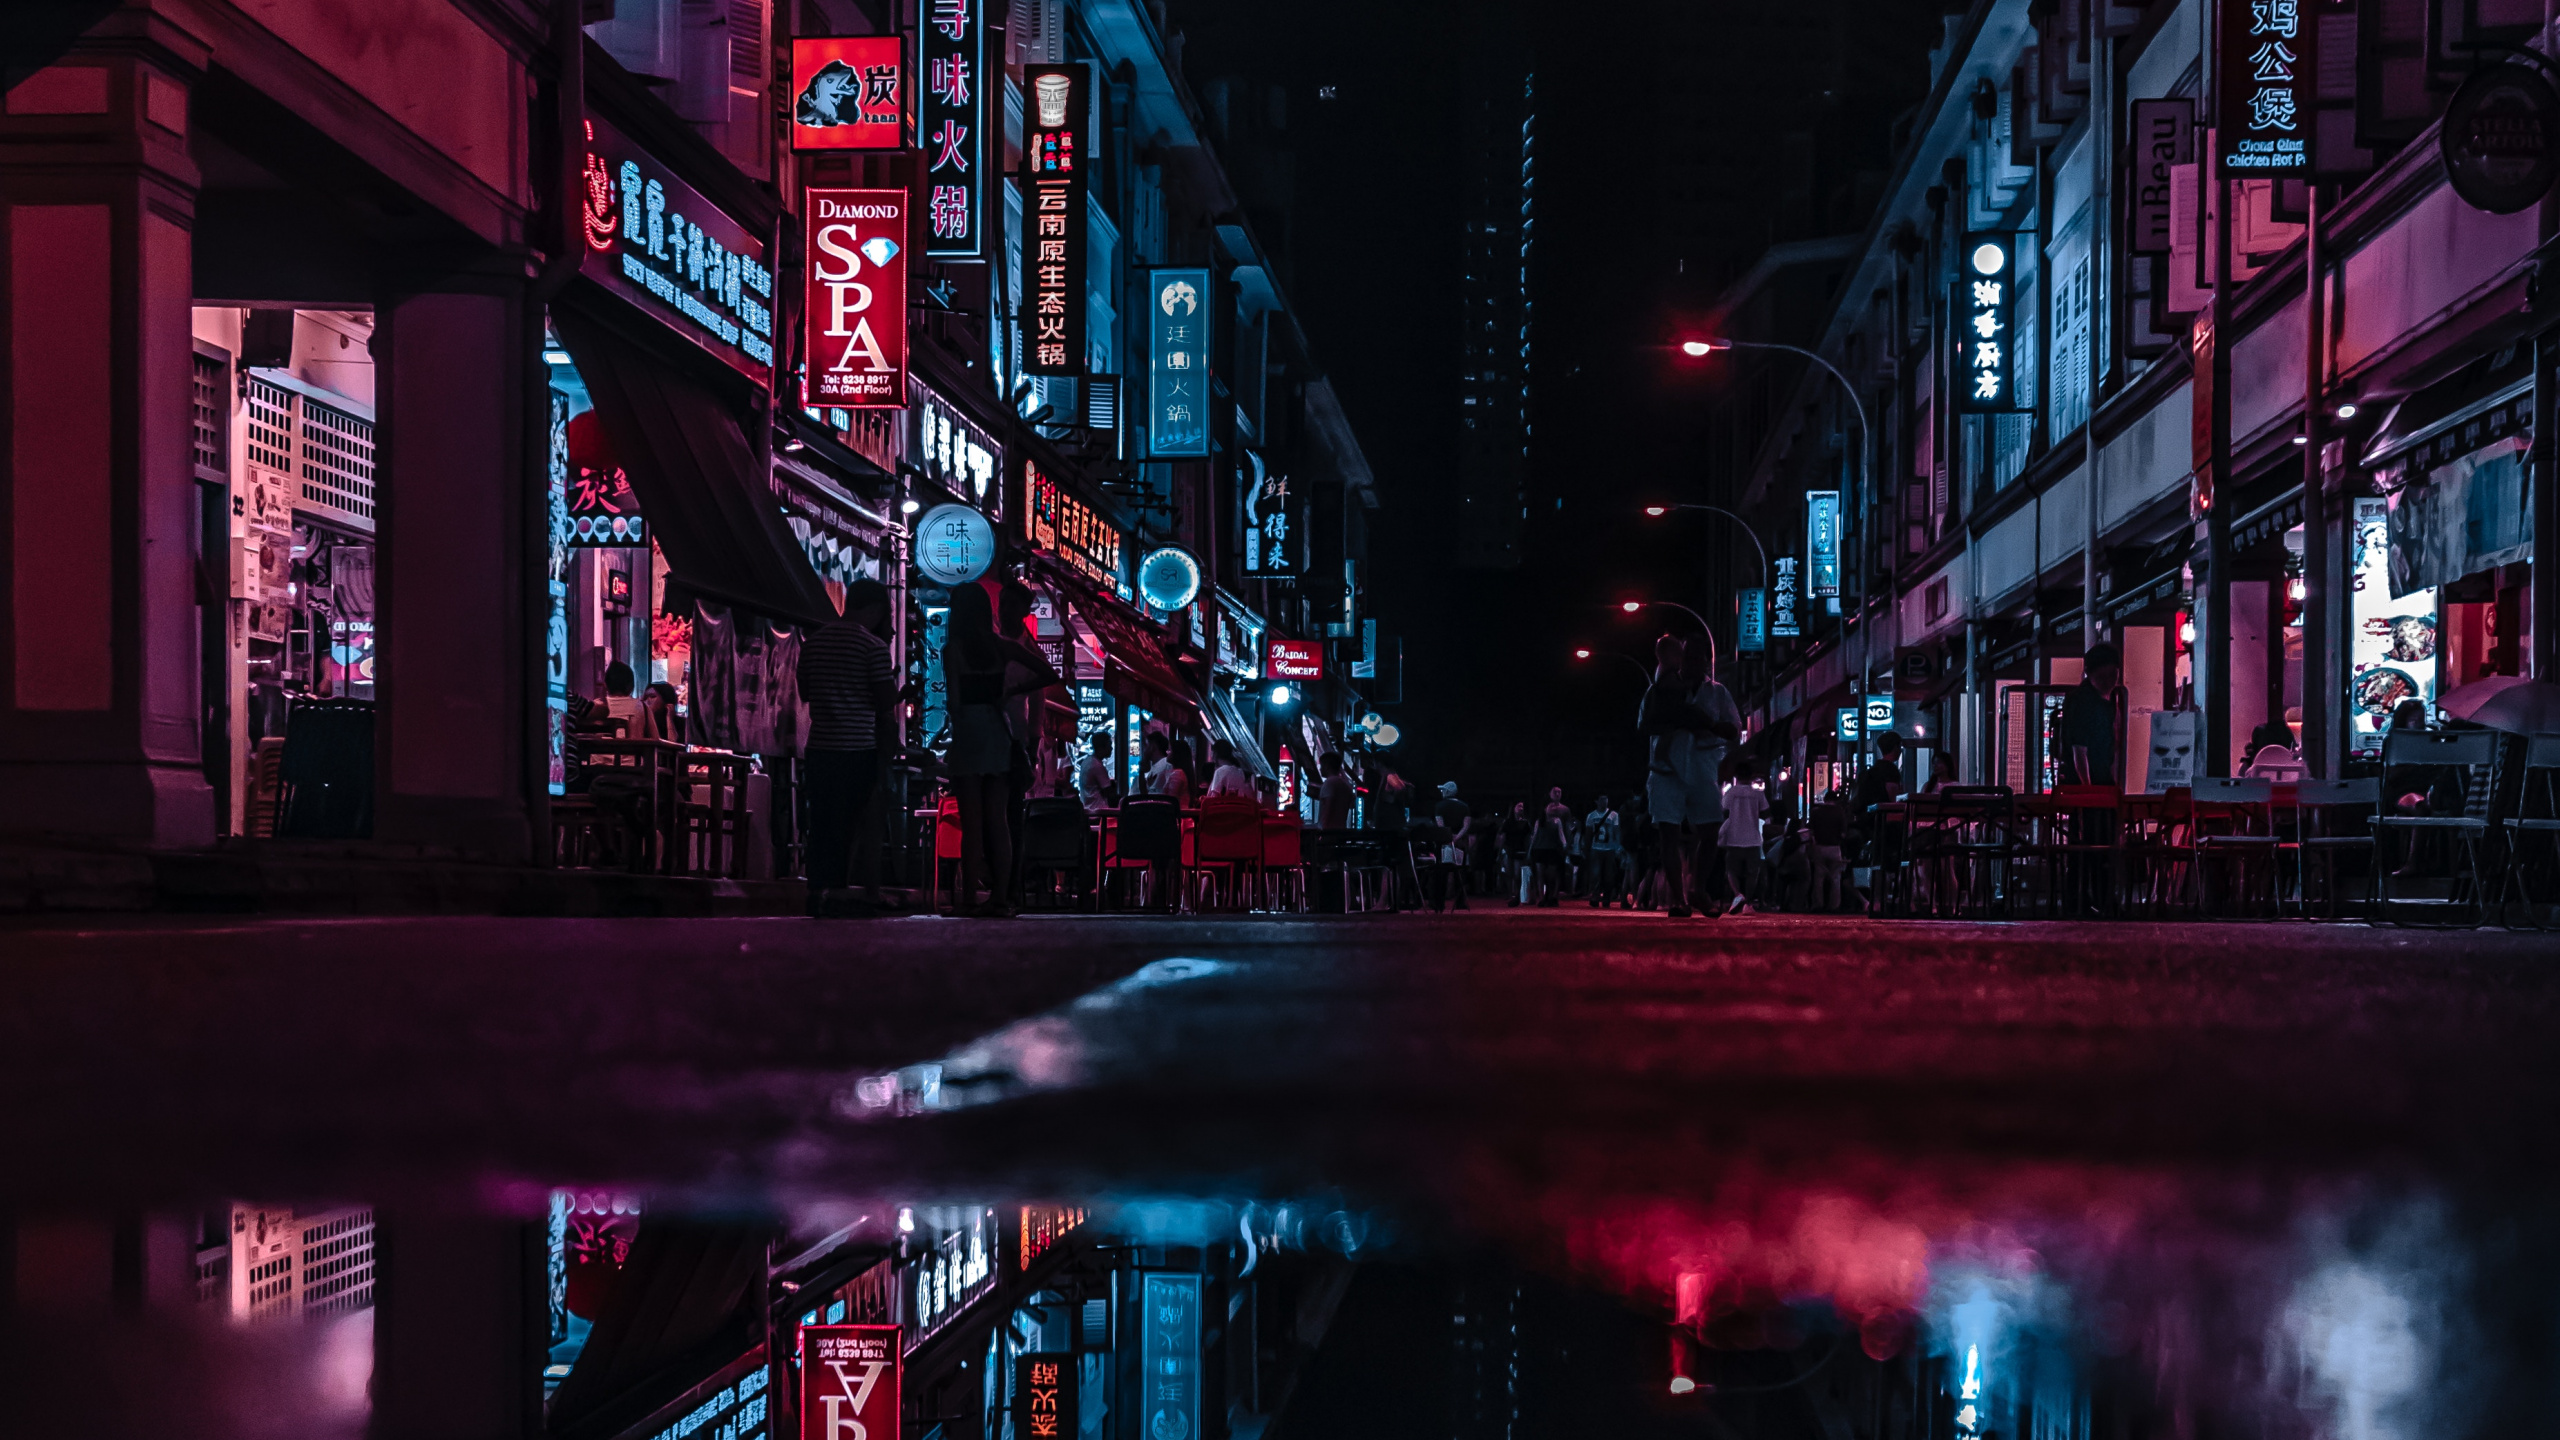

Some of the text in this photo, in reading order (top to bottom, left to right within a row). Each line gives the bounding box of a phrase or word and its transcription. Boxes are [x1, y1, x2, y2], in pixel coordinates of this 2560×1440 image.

[864, 65, 898, 107] 炭
[863, 111, 898, 124] taan
[2271, 153, 2295, 167] Hot
[819, 199, 899, 219] DIAMOND
[1037, 188, 1067, 366] 云南原生态火锅
[814, 224, 898, 372] SPA
[823, 374, 890, 385] Tel: 6238 8917
[820, 384, 892, 397] 30A (2nd Floor)
[1867, 707, 1891, 718] NO.1
